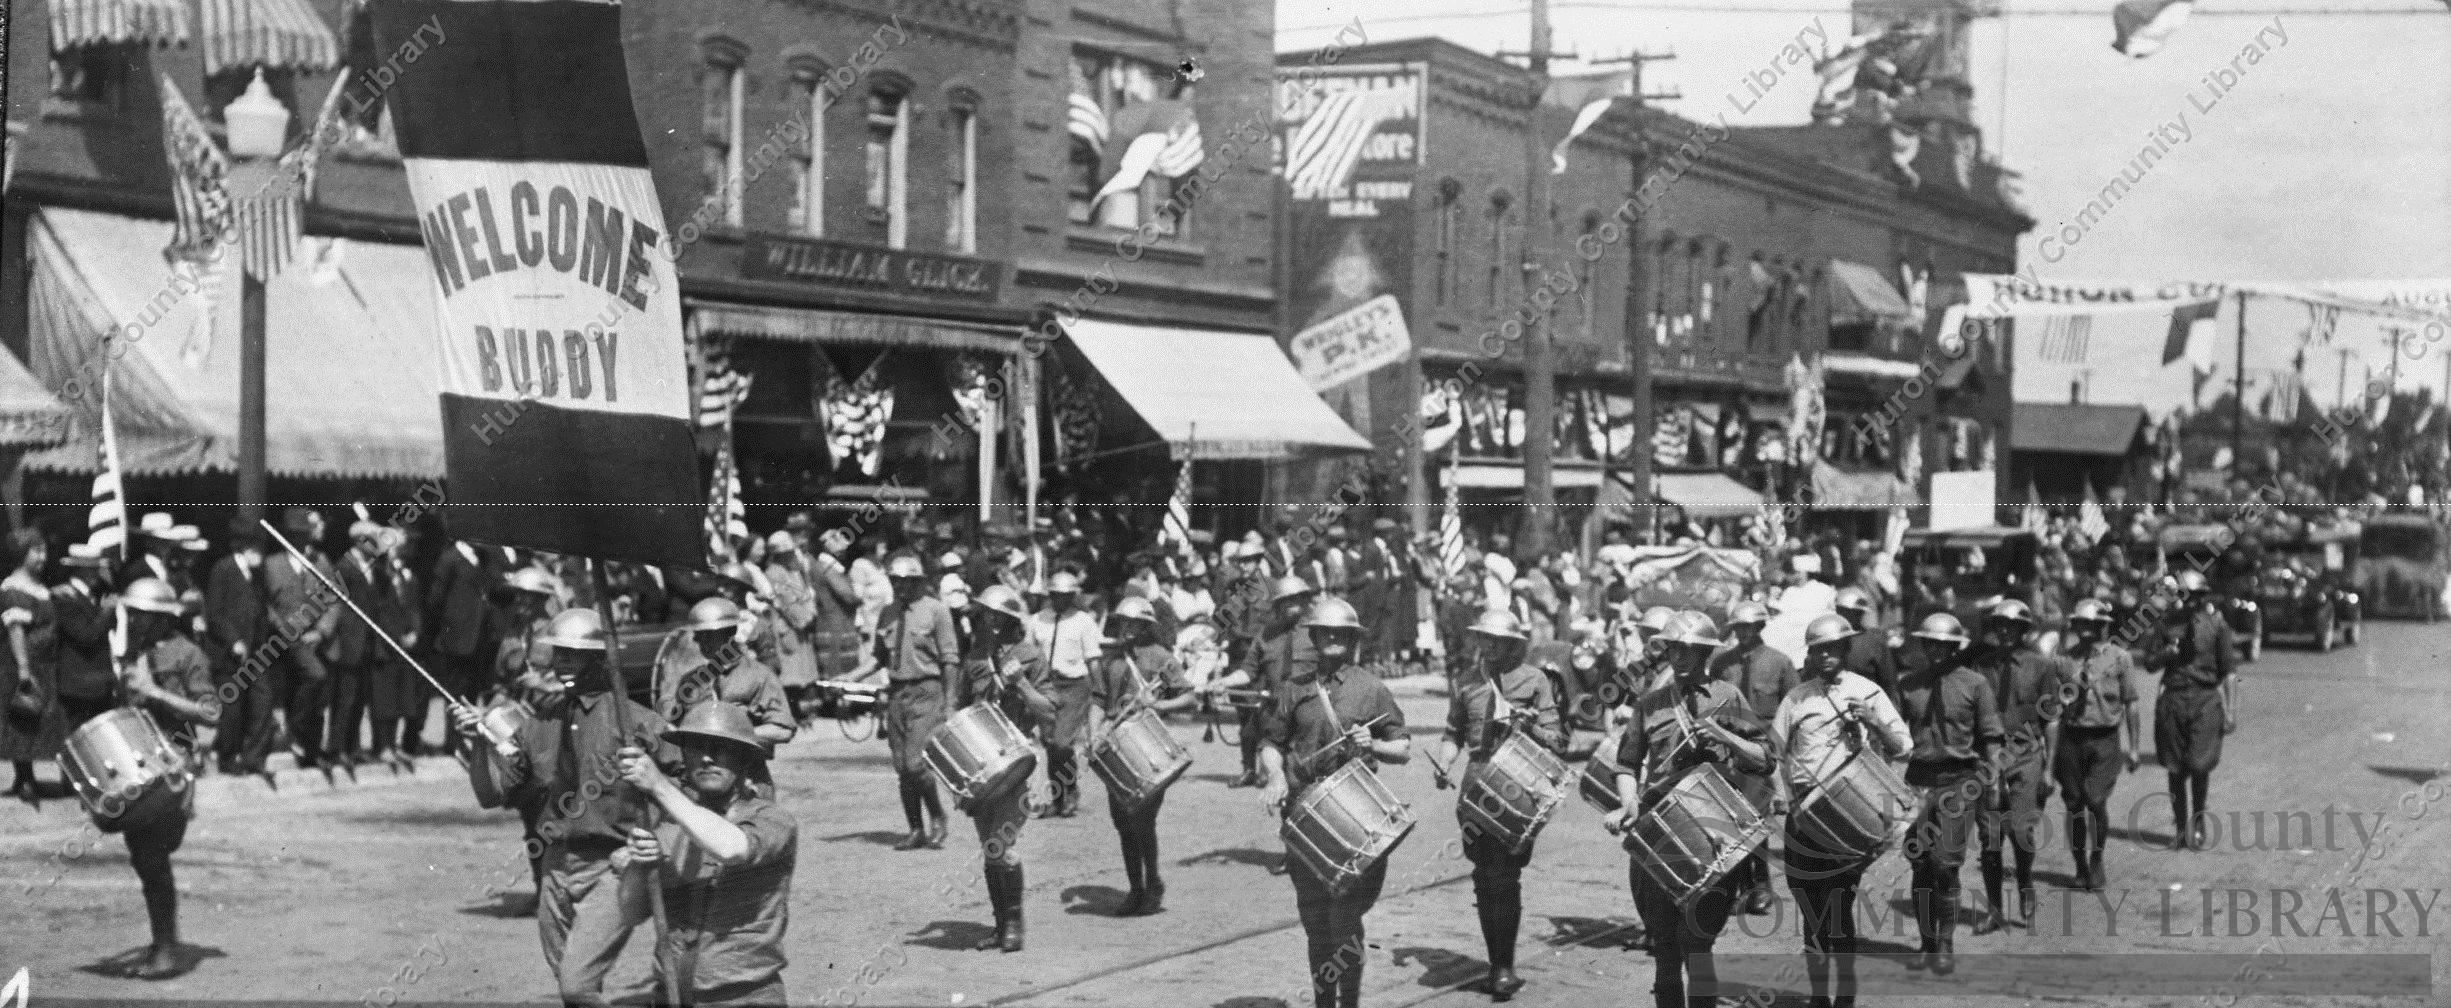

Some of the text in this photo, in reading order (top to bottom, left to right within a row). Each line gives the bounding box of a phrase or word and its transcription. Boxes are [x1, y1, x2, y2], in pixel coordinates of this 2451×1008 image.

[423, 180, 660, 313] WELCOME
[767, 243, 892, 282] WILLIAM
[475, 324, 617, 403] BUDDY
